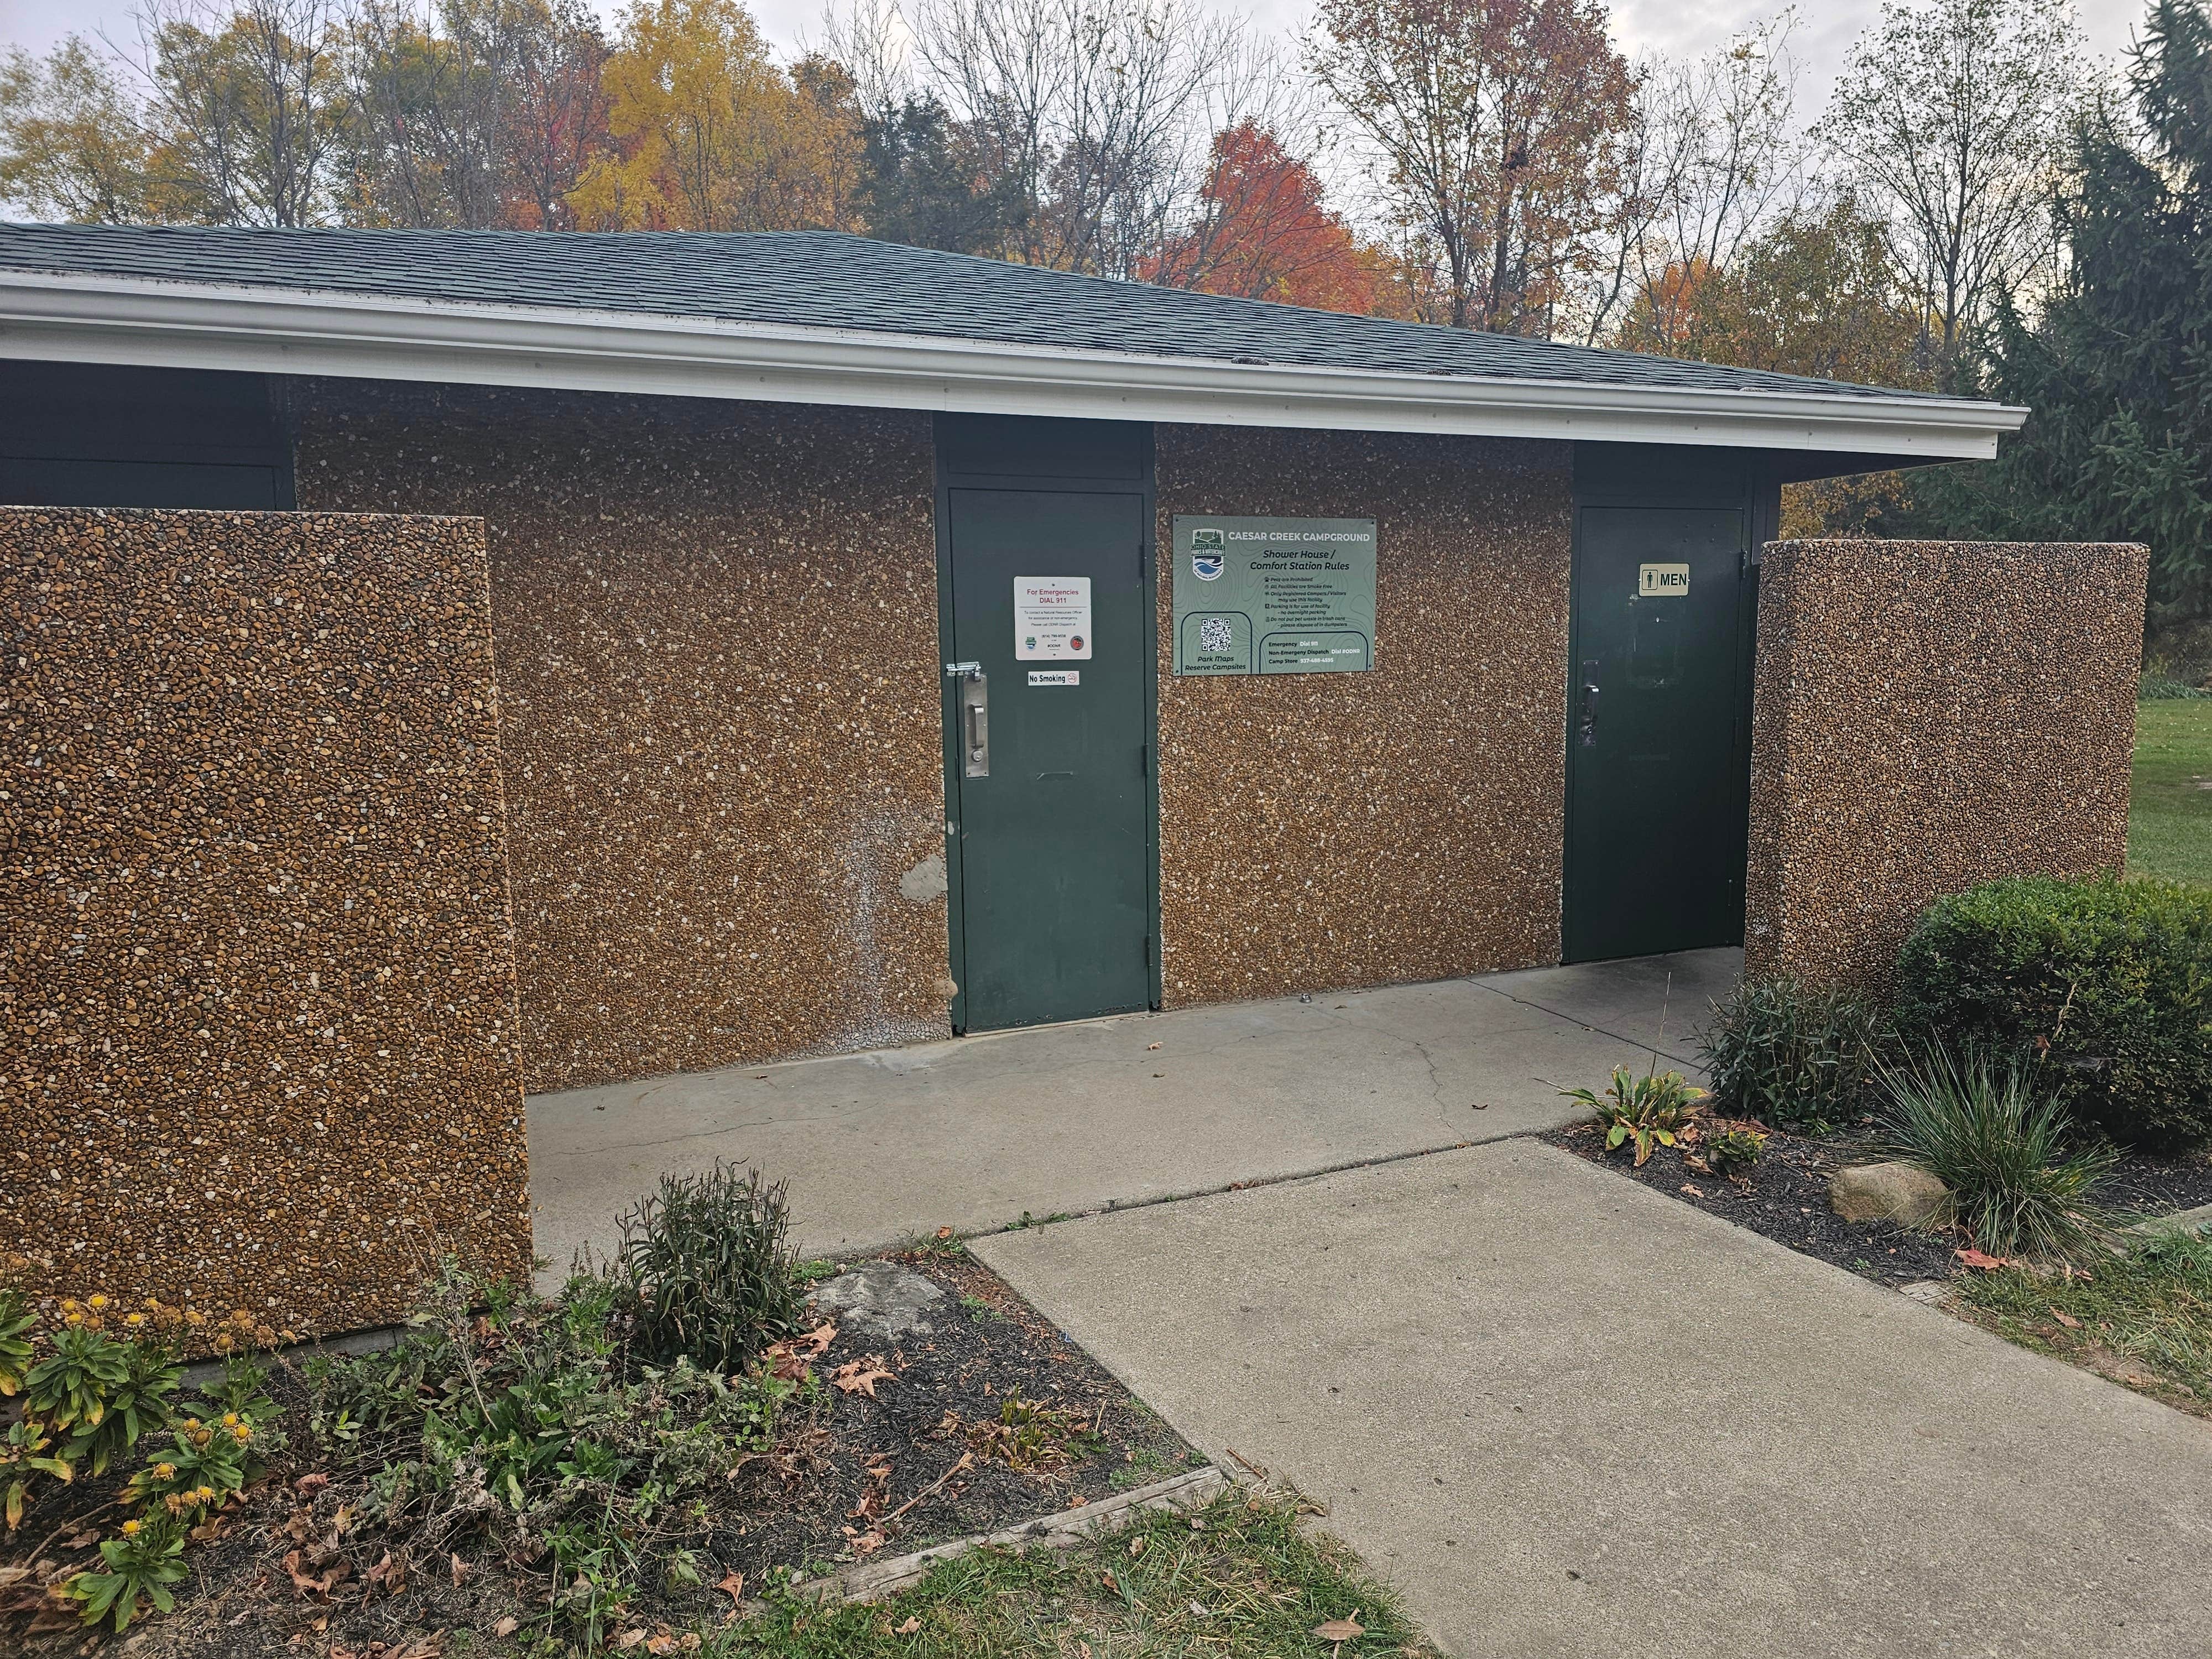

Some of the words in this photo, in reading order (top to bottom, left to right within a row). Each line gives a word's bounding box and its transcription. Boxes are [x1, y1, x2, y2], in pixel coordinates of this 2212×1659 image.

[1228, 531, 1267, 540] CAESAR
[1269, 532, 1301, 541] CREEK
[1303, 533, 1370, 541] CAMPGROUND
[1263, 550, 1298, 559] Shower
[1300, 550, 1329, 559] House
[1330, 549, 1336, 559] /
[1250, 561, 1287, 570] Comfort
[1289, 561, 1323, 570] Station
[1324, 561, 1349, 570] Rules
[1660, 573, 1687, 586] MEN
[1039, 674, 1066, 684] Smoking
